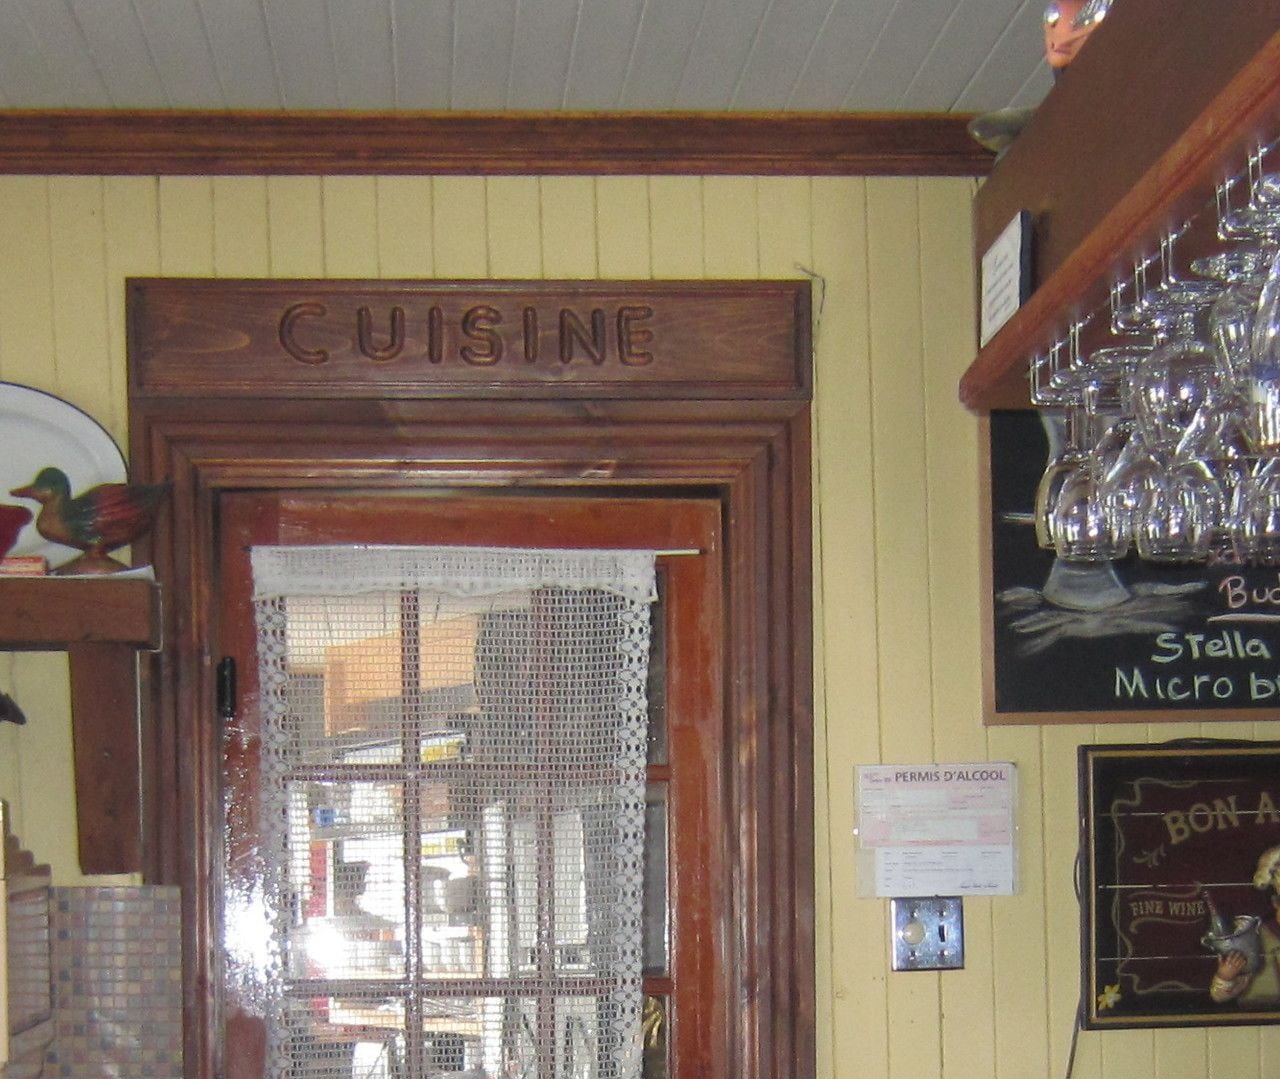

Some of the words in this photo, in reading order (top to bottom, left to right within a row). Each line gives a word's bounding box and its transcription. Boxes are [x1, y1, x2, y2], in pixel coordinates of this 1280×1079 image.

[278, 302, 654, 367] CUISINE
[1150, 629, 1271, 664] Stella
[1114, 666, 1233, 700] Micro
[894, 771, 940, 783] PERMIS
[943, 769, 1007, 782] D'ALCOOL
[1161, 794, 1241, 845] BON
[1129, 899, 1164, 916] FINE
[1168, 899, 1206, 916] WINE
